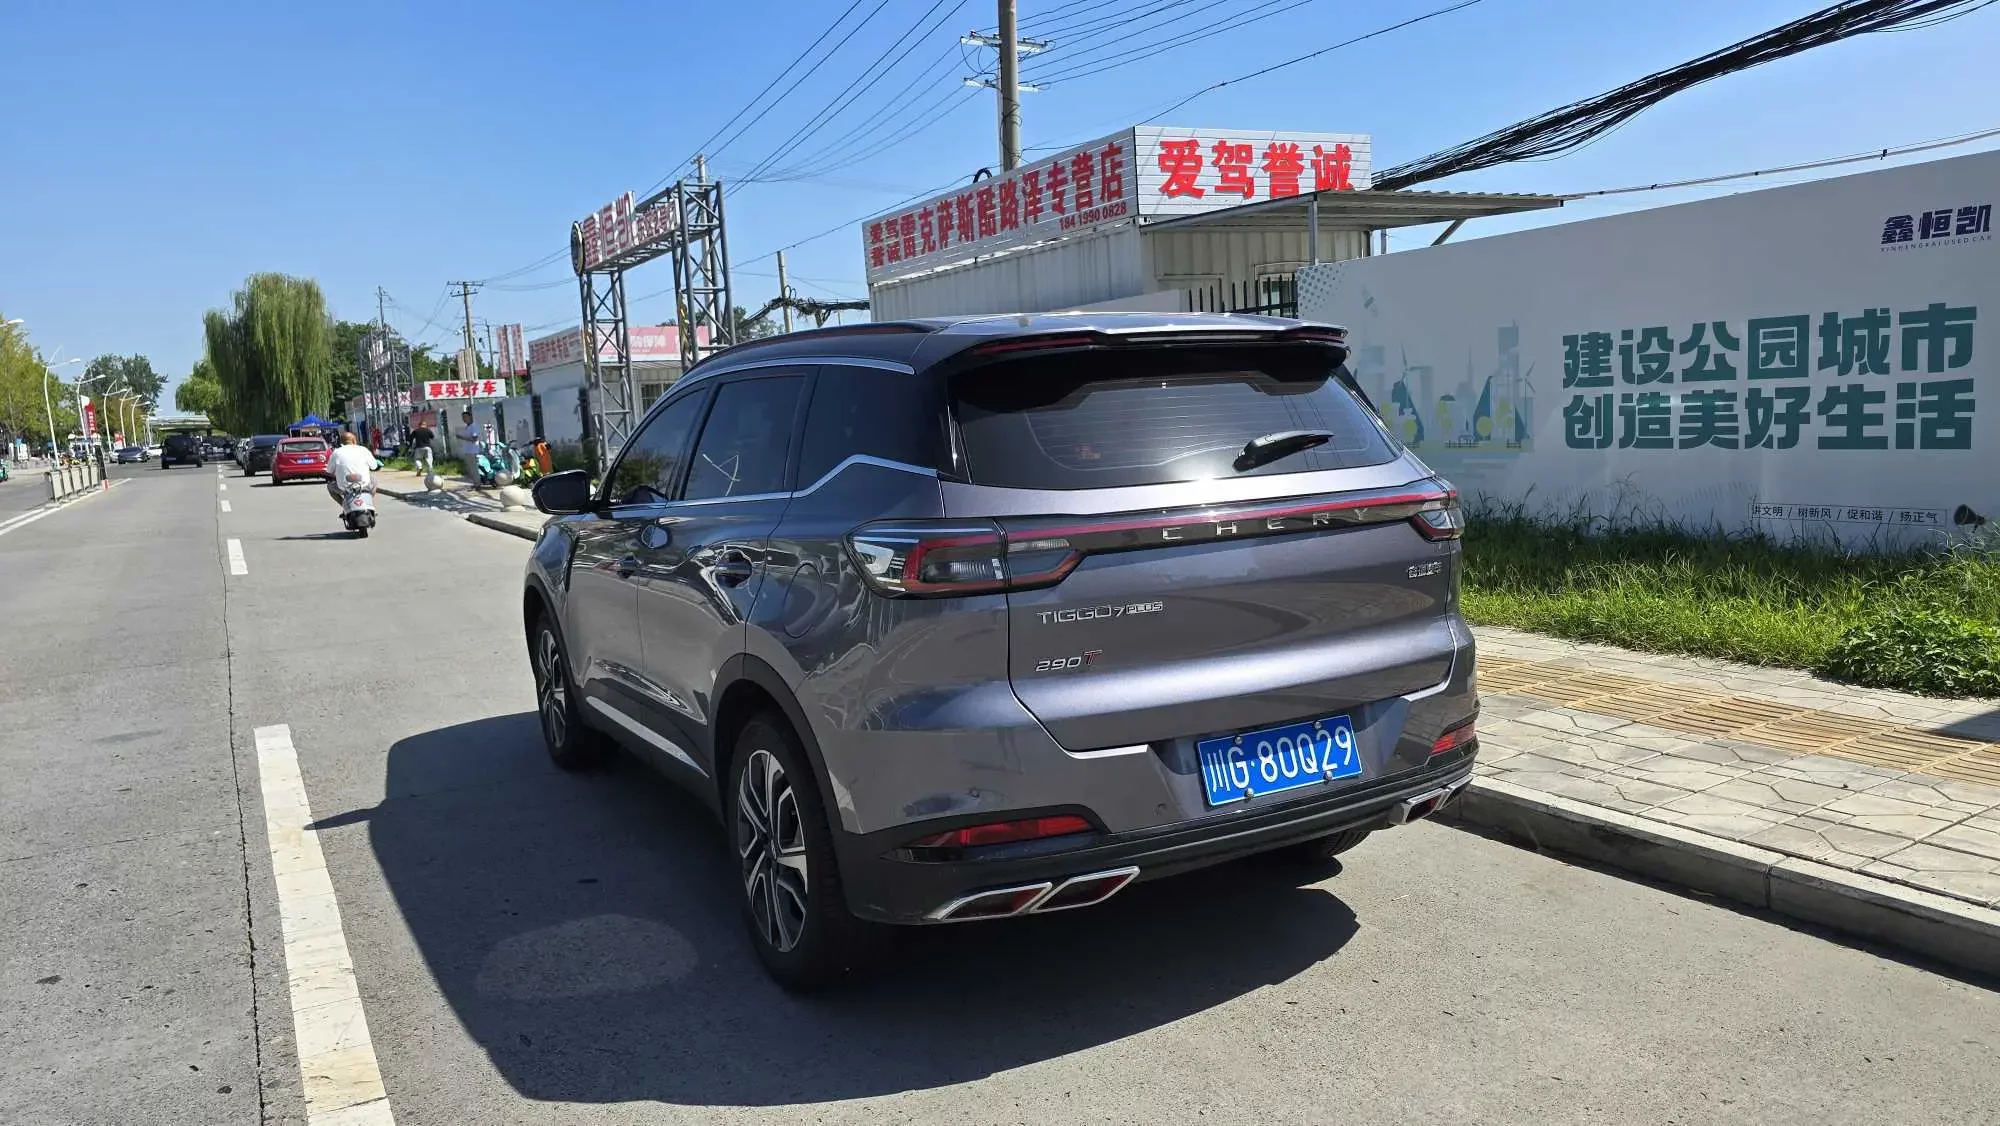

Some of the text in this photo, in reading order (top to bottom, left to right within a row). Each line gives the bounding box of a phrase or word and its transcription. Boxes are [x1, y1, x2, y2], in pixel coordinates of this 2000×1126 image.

[1157, 139, 1354, 200] 爱驾誉诚
[900, 142, 1124, 258] 雷克萨斯酷路泽专营店
[1060, 201, 1127, 230] 184 1990 0828
[1881, 204, 1992, 244] 鑫恒凯
[1562, 303, 1977, 391] 建设公园城市
[1562, 378, 1976, 450] 创造美好生活
[1162, 507, 1369, 540] CHERY
[1752, 505, 1783, 517] 讲文明
[1798, 507, 1832, 519] 树新风
[1847, 508, 1883, 521] 促和谐
[1900, 511, 1938, 524] 扬正气
